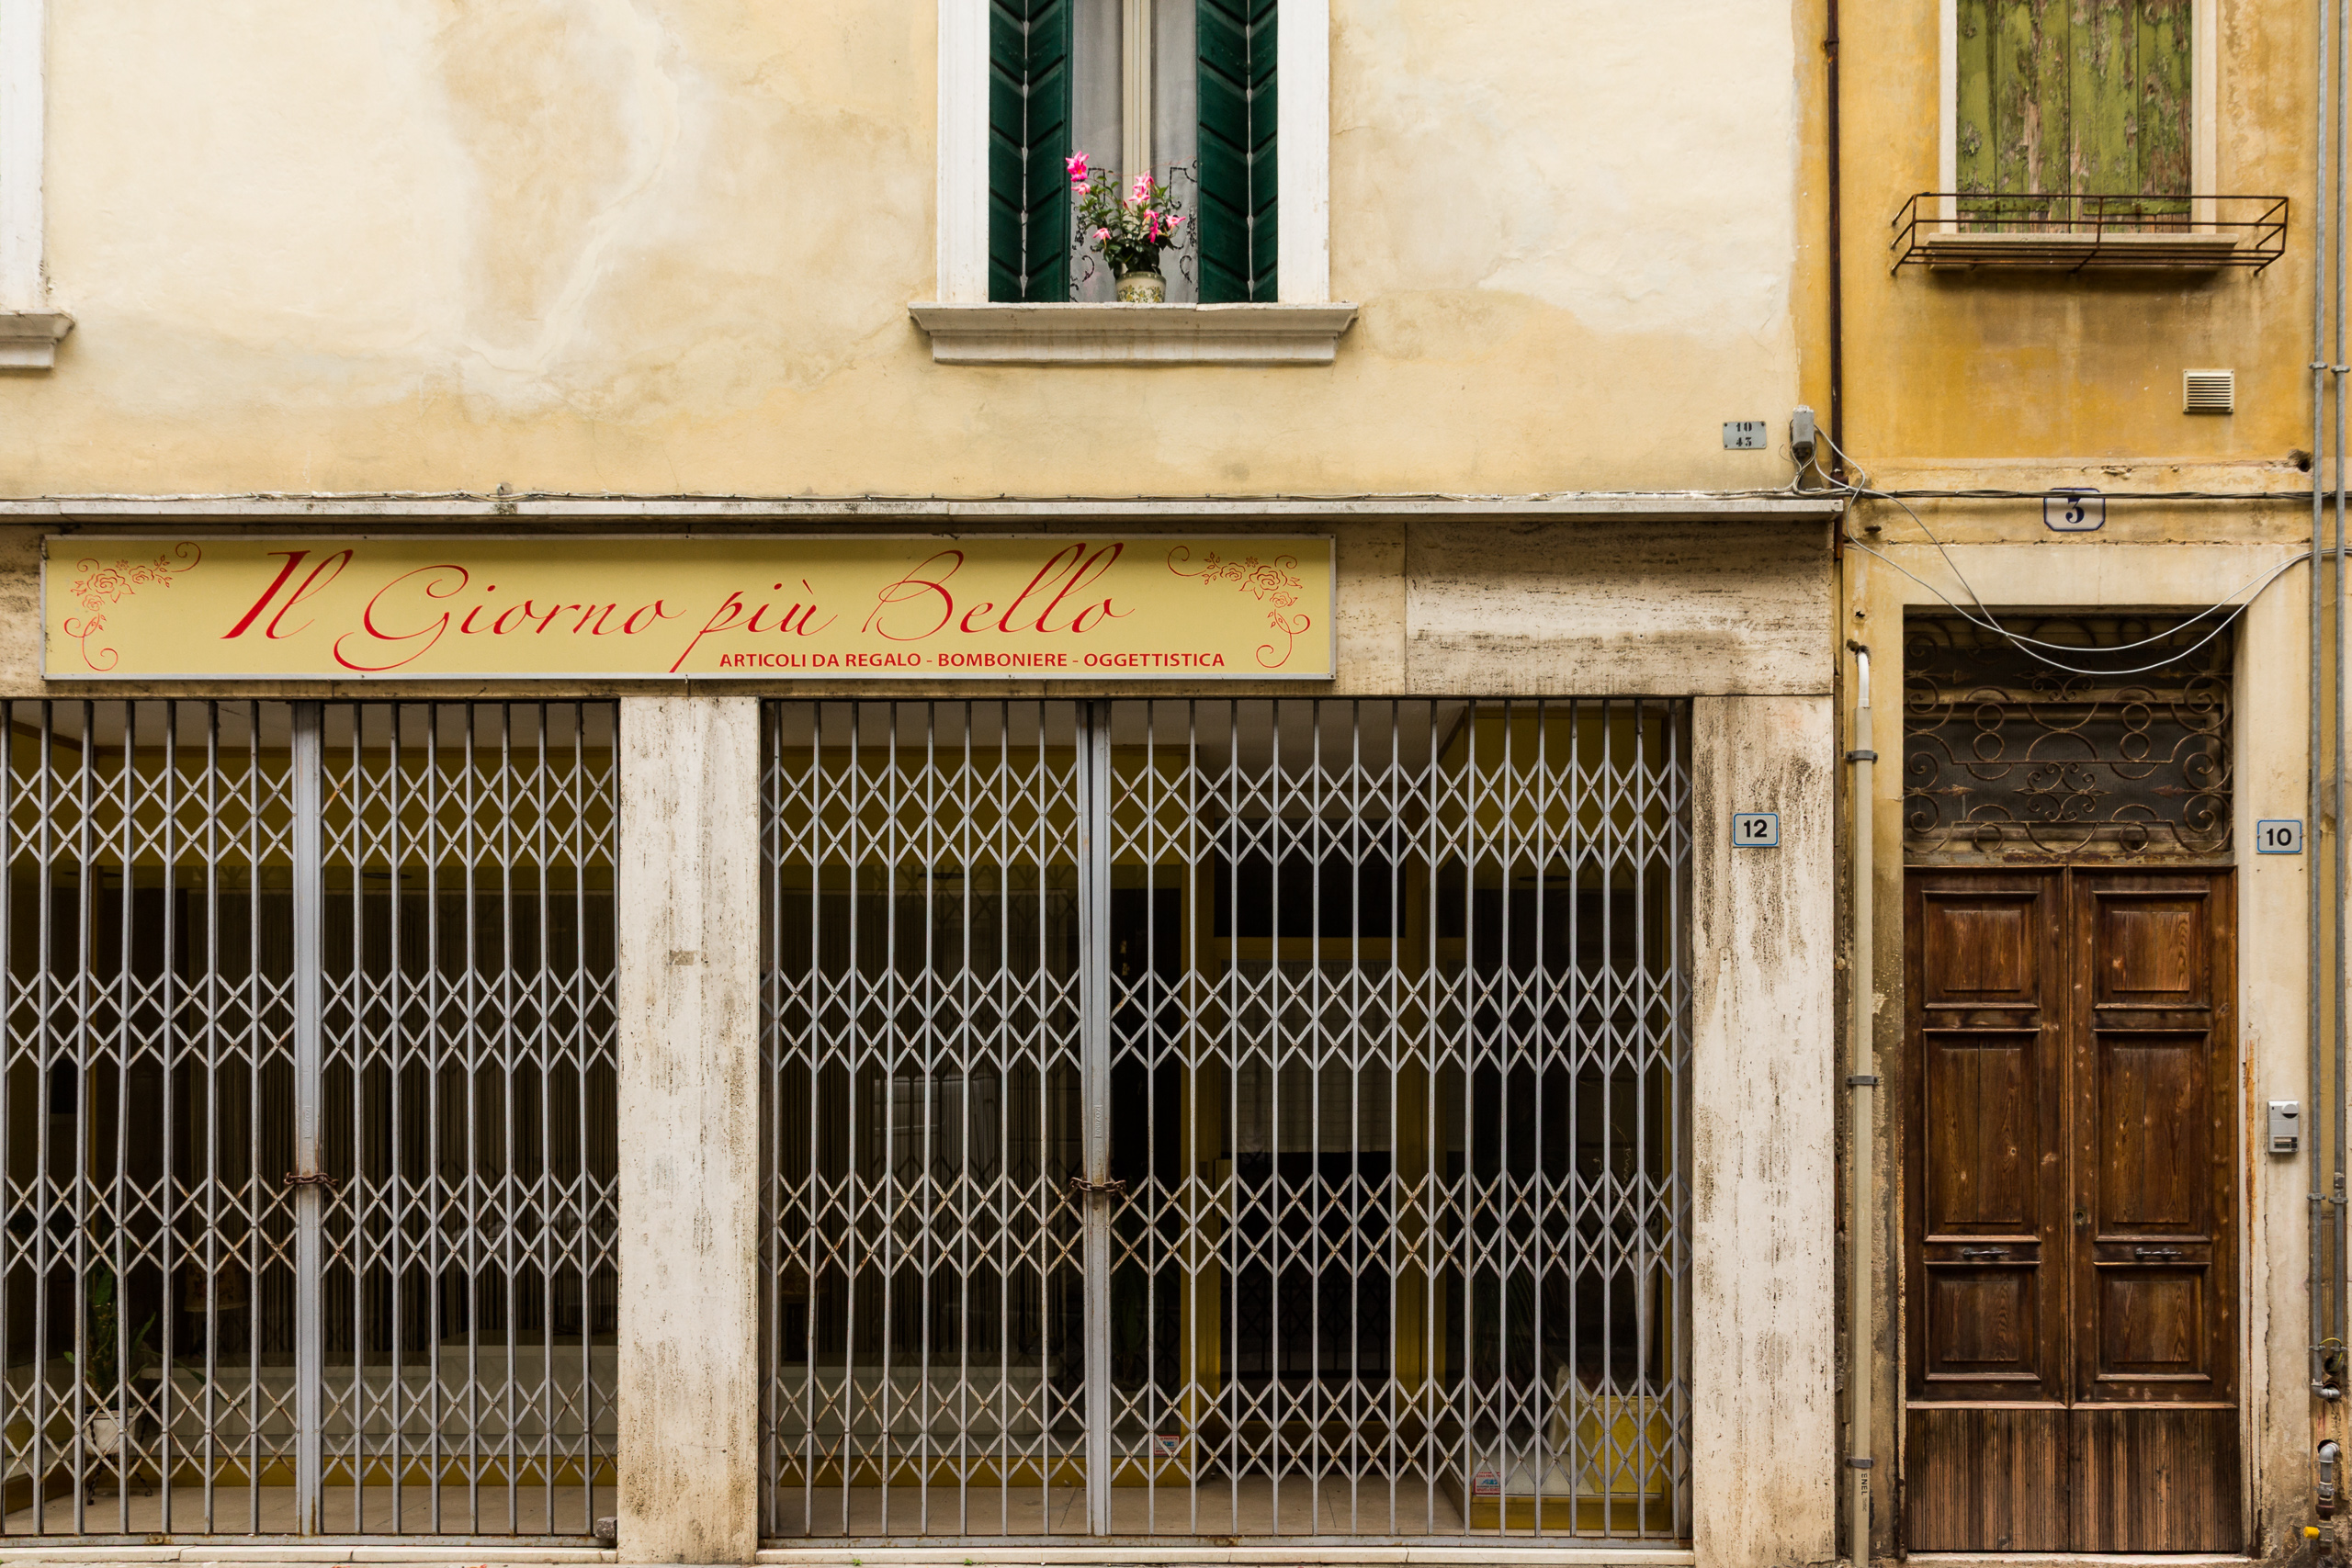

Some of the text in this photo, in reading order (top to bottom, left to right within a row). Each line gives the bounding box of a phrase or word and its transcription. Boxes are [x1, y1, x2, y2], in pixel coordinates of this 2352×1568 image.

[1736, 422, 1753, 432] 10
[2064, 494, 2085, 525] 3
[220, 542, 1136, 674] Il Giorno più Bello
[718, 652, 807, 669] ARTICOLI
[811, 652, 841, 669] DA
[844, 652, 922, 669] REGALO
[937, 652, 1069, 669] BOMBONIERE
[1083, 652, 1226, 669] OGGETTISTICA
[1743, 818, 1768, 838] 12
[2266, 828, 2292, 847] 10
